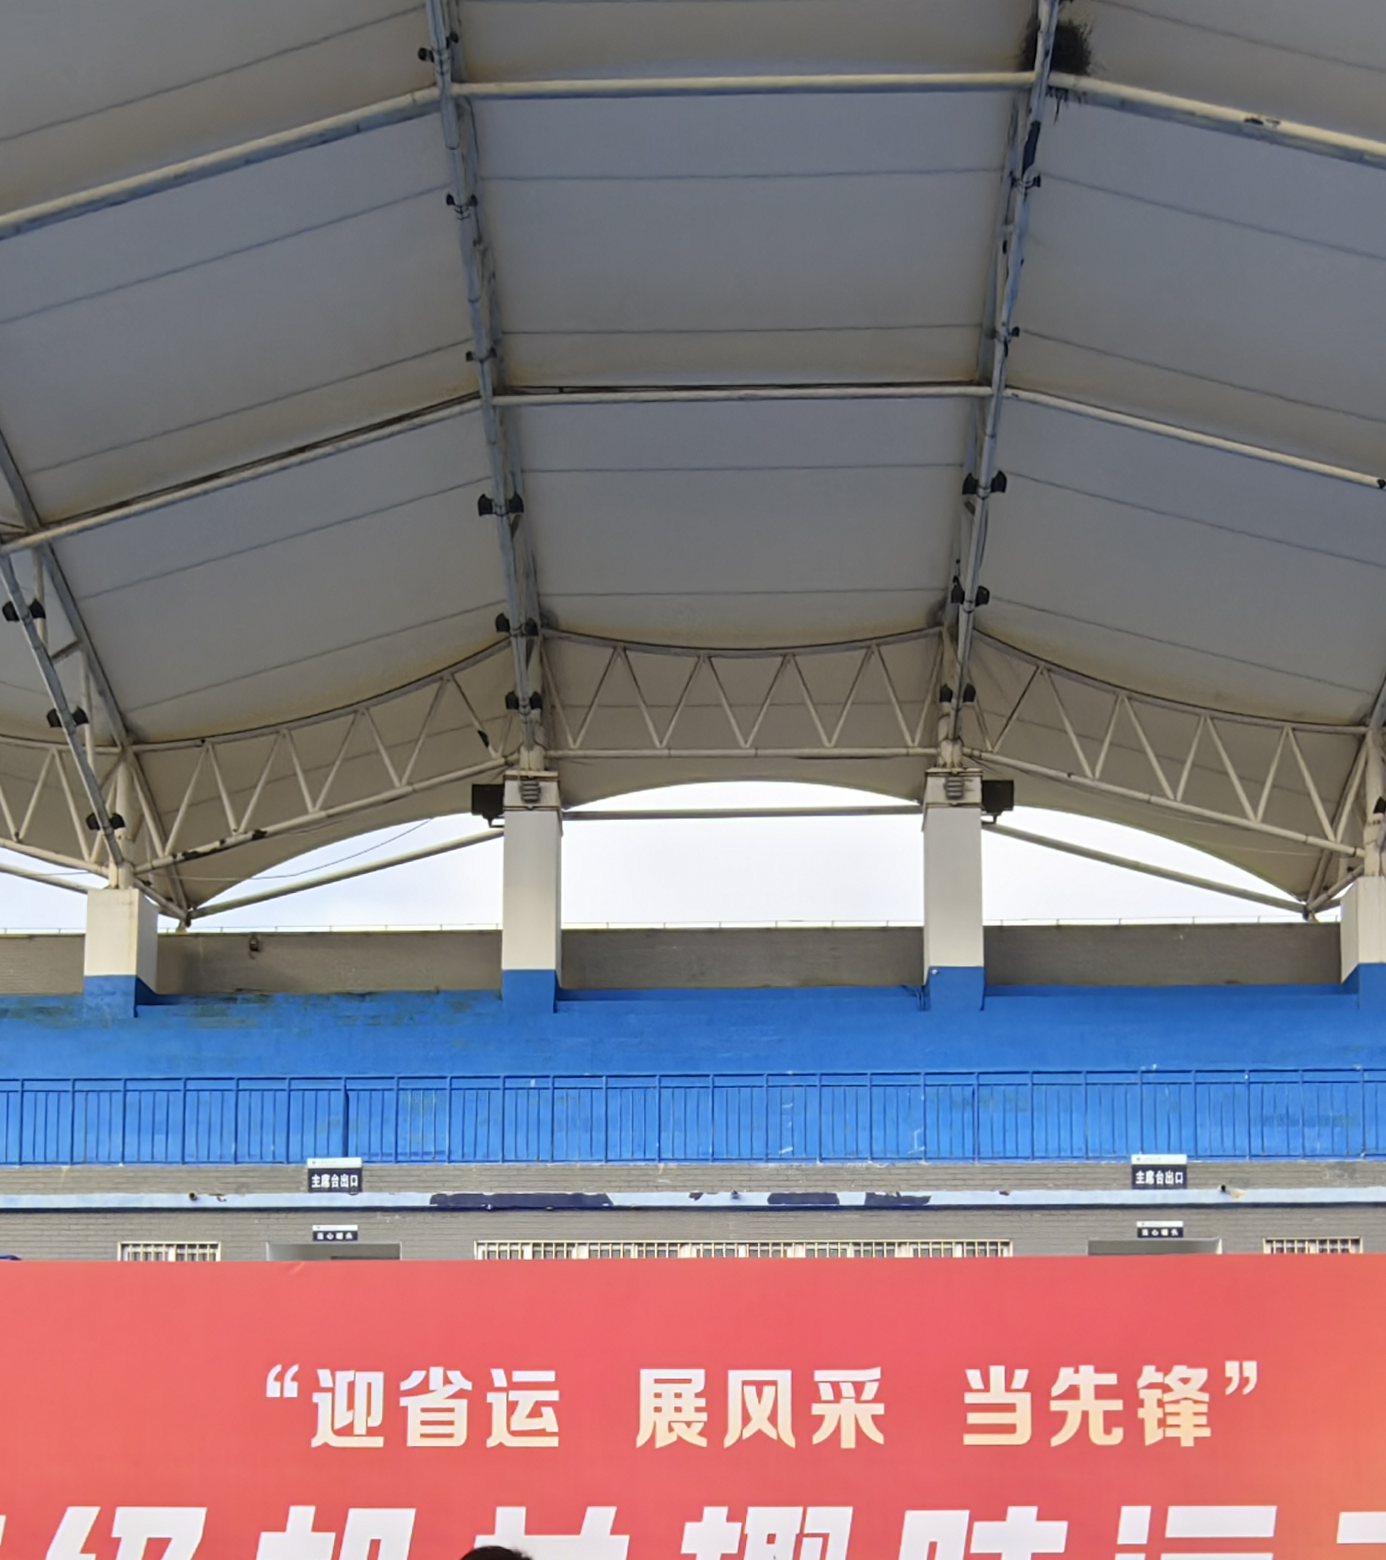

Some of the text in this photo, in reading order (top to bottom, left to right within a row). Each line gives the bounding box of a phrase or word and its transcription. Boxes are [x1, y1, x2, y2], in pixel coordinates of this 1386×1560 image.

[266, 1360, 1259, 1450] “迎省运 展风采 当先锋”
